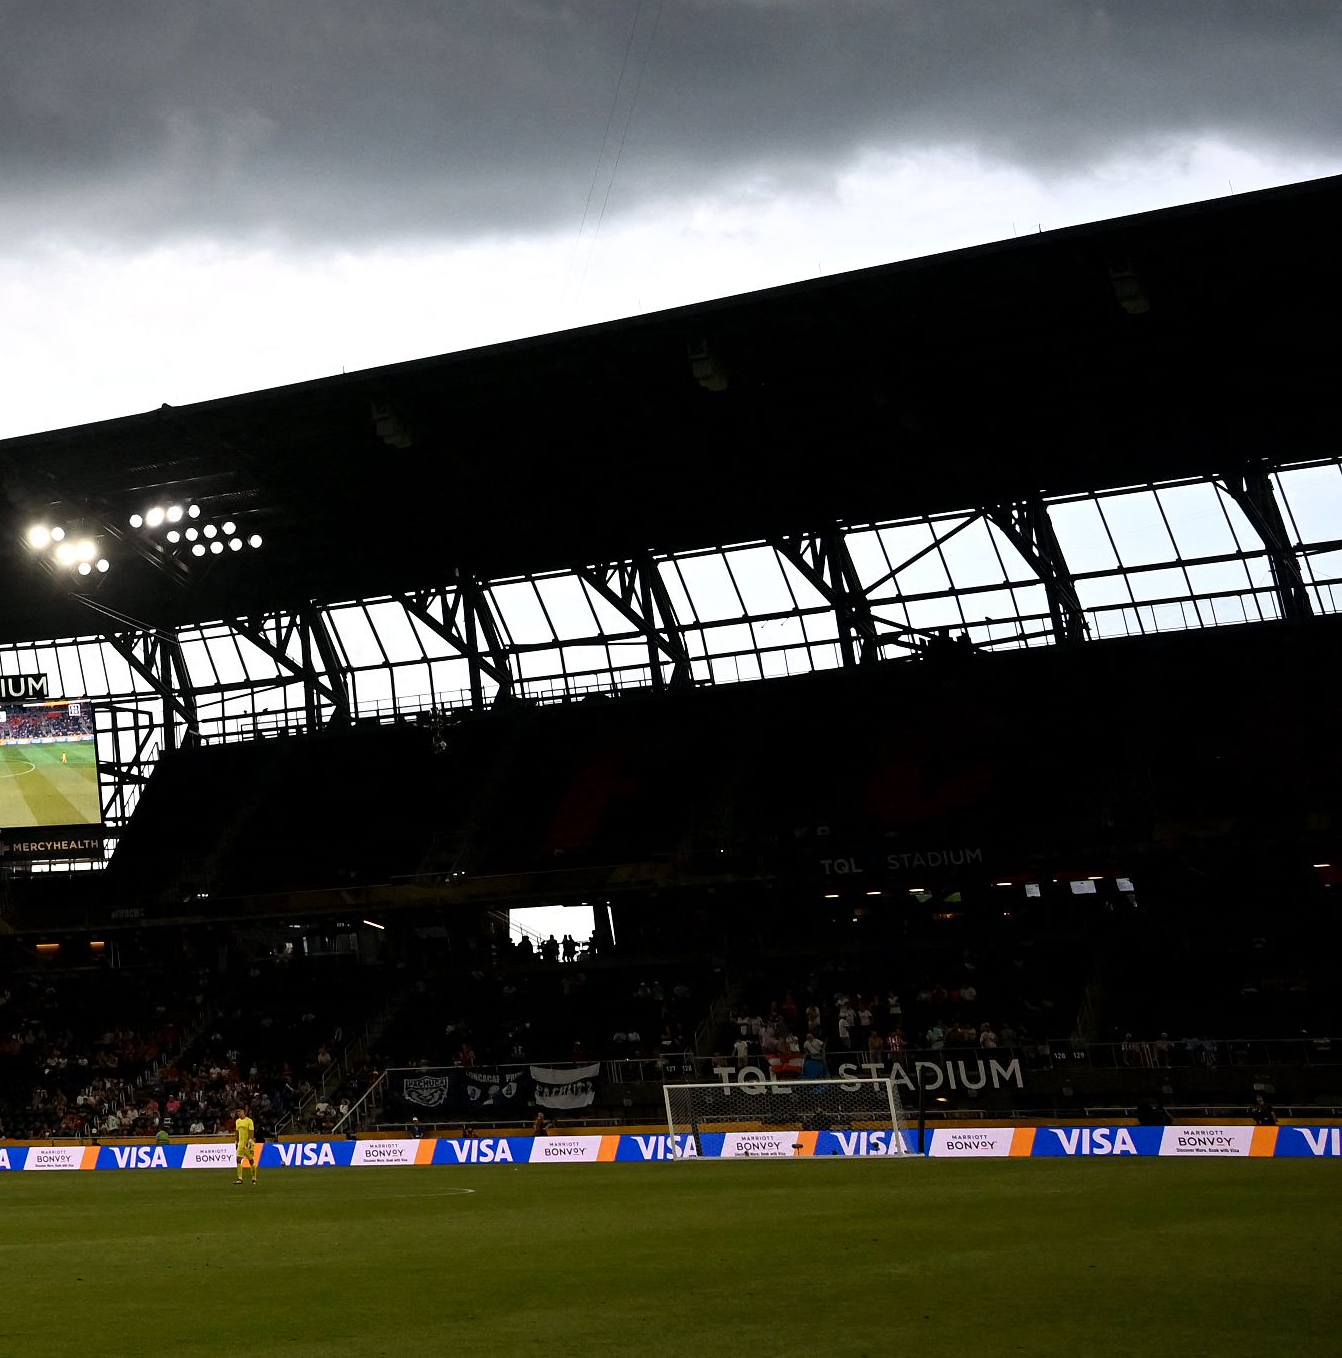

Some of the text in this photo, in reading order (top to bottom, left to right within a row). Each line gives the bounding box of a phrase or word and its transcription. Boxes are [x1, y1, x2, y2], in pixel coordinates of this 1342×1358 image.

[12, 838, 99, 853] MERCYHEALTH
[819, 847, 983, 875] TQL STADIUM
[713, 1058, 1025, 1096] TQL STADIUM
[630, 1135, 699, 1159] VISA
[736, 1142, 780, 1151] BONVOY
[829, 1131, 908, 1156] VISA
[946, 1141, 995, 1150] BONVOY
[1048, 1128, 1138, 1155] VISA
[1178, 1137, 1232, 1147] BONVOY
[37, 1155, 71, 1163] BONVOY
[109, 1146, 168, 1168] VISA
[195, 1154, 232, 1163] BONVOY
[273, 1142, 336, 1165] VISA
[365, 1149, 404, 1158] BONVOY
[446, 1139, 513, 1163] VISA
[544, 1148, 585, 1157] BONVOY
